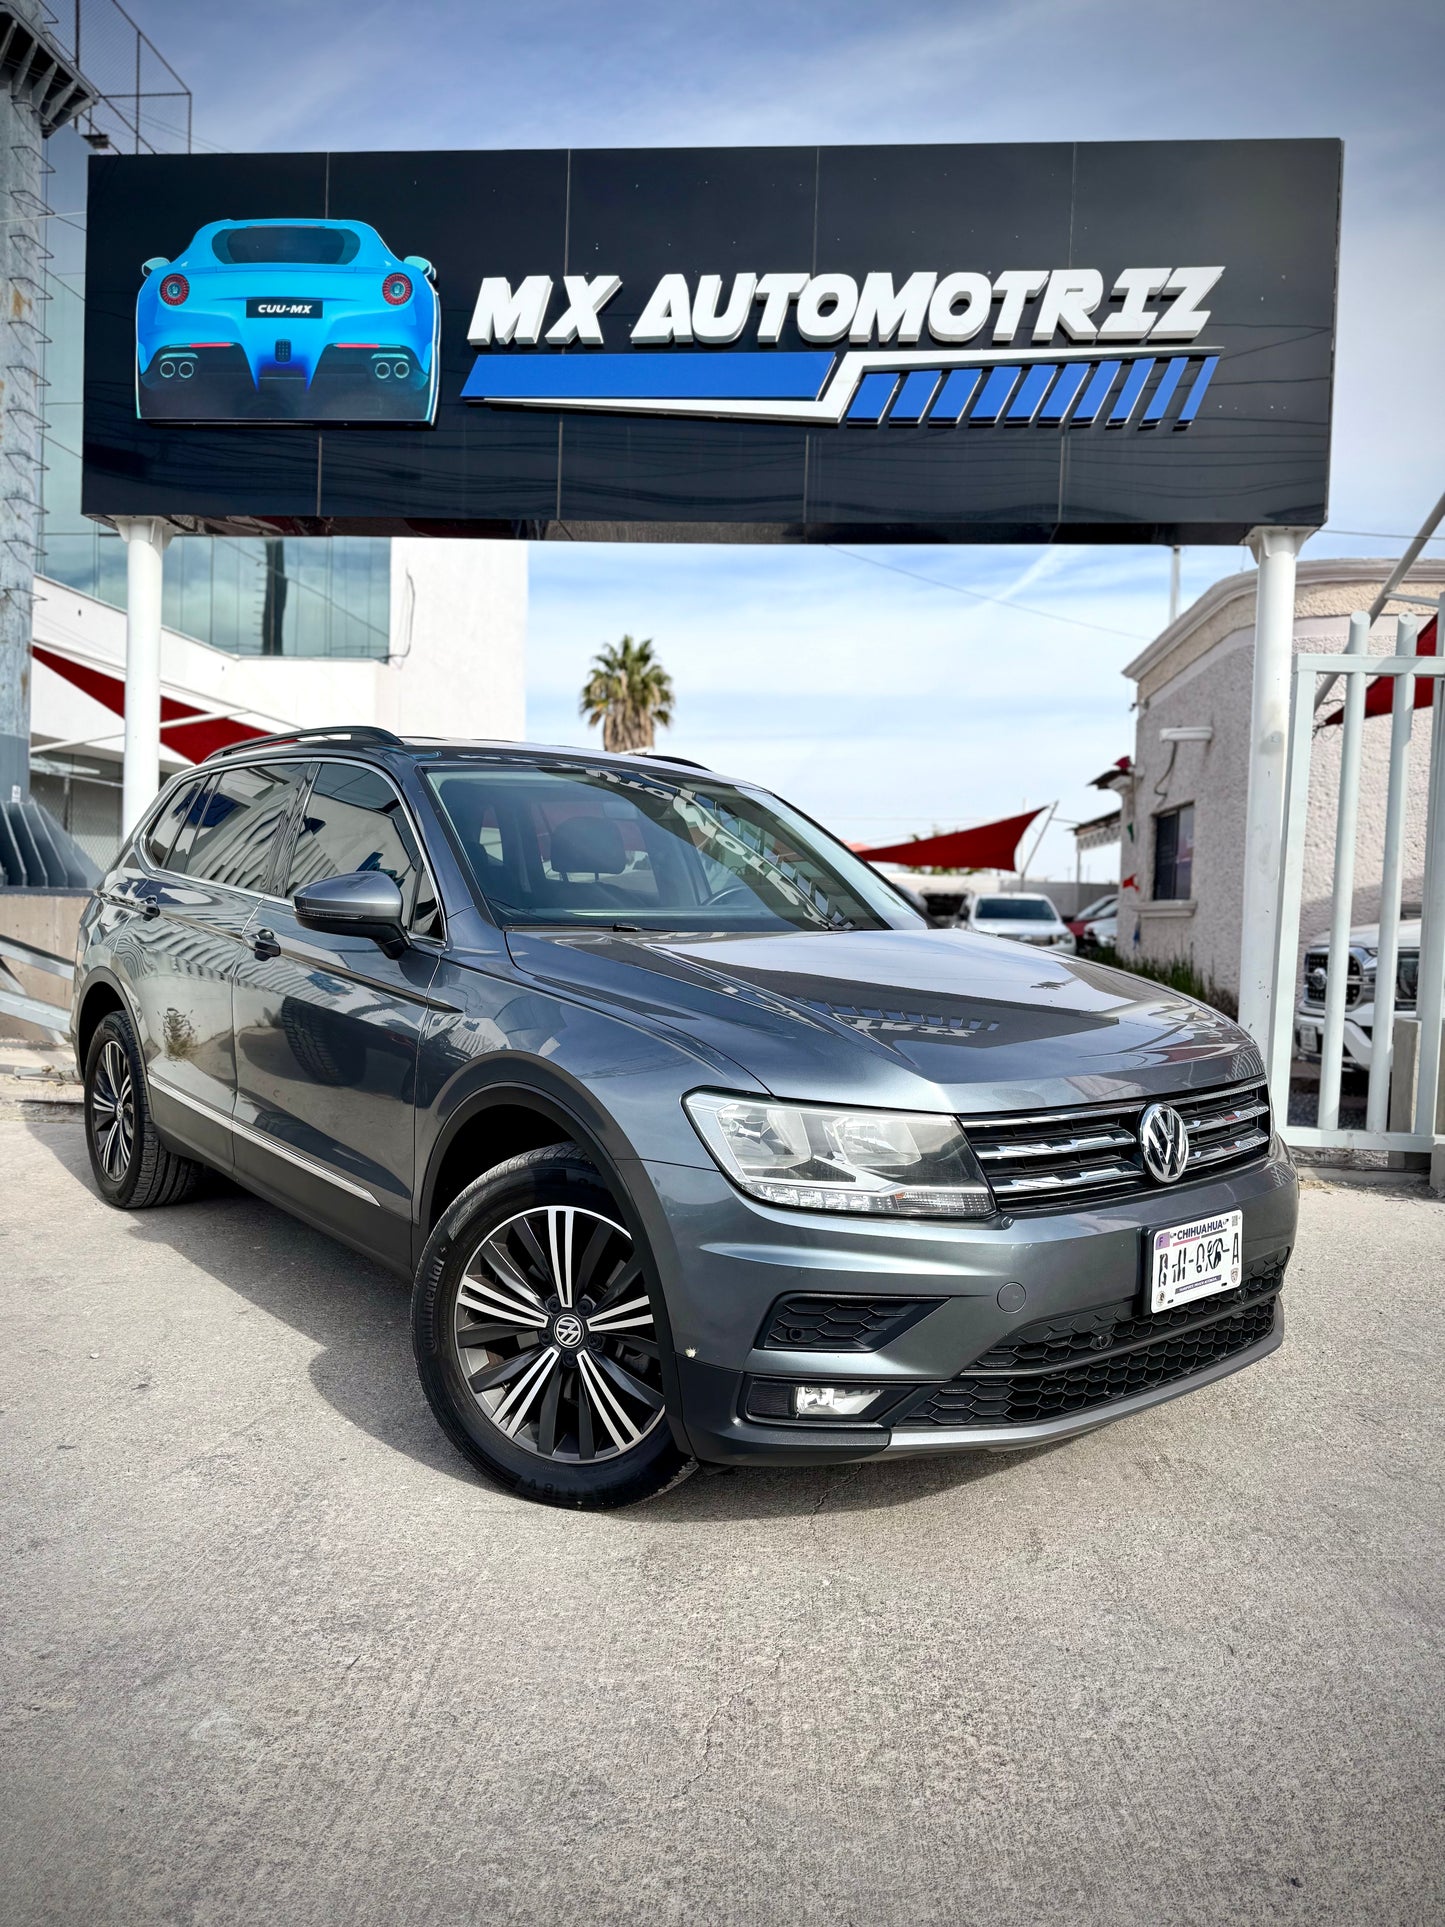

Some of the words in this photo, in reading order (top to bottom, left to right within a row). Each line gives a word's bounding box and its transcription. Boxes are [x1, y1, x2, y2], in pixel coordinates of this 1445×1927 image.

[257, 304, 313, 314] CUU-MX
[467, 275, 623, 345] MX
[630, 266, 1225, 345] AUTOMOTRIZ
[1176, 1219, 1223, 1241] CHIHUAHUA
